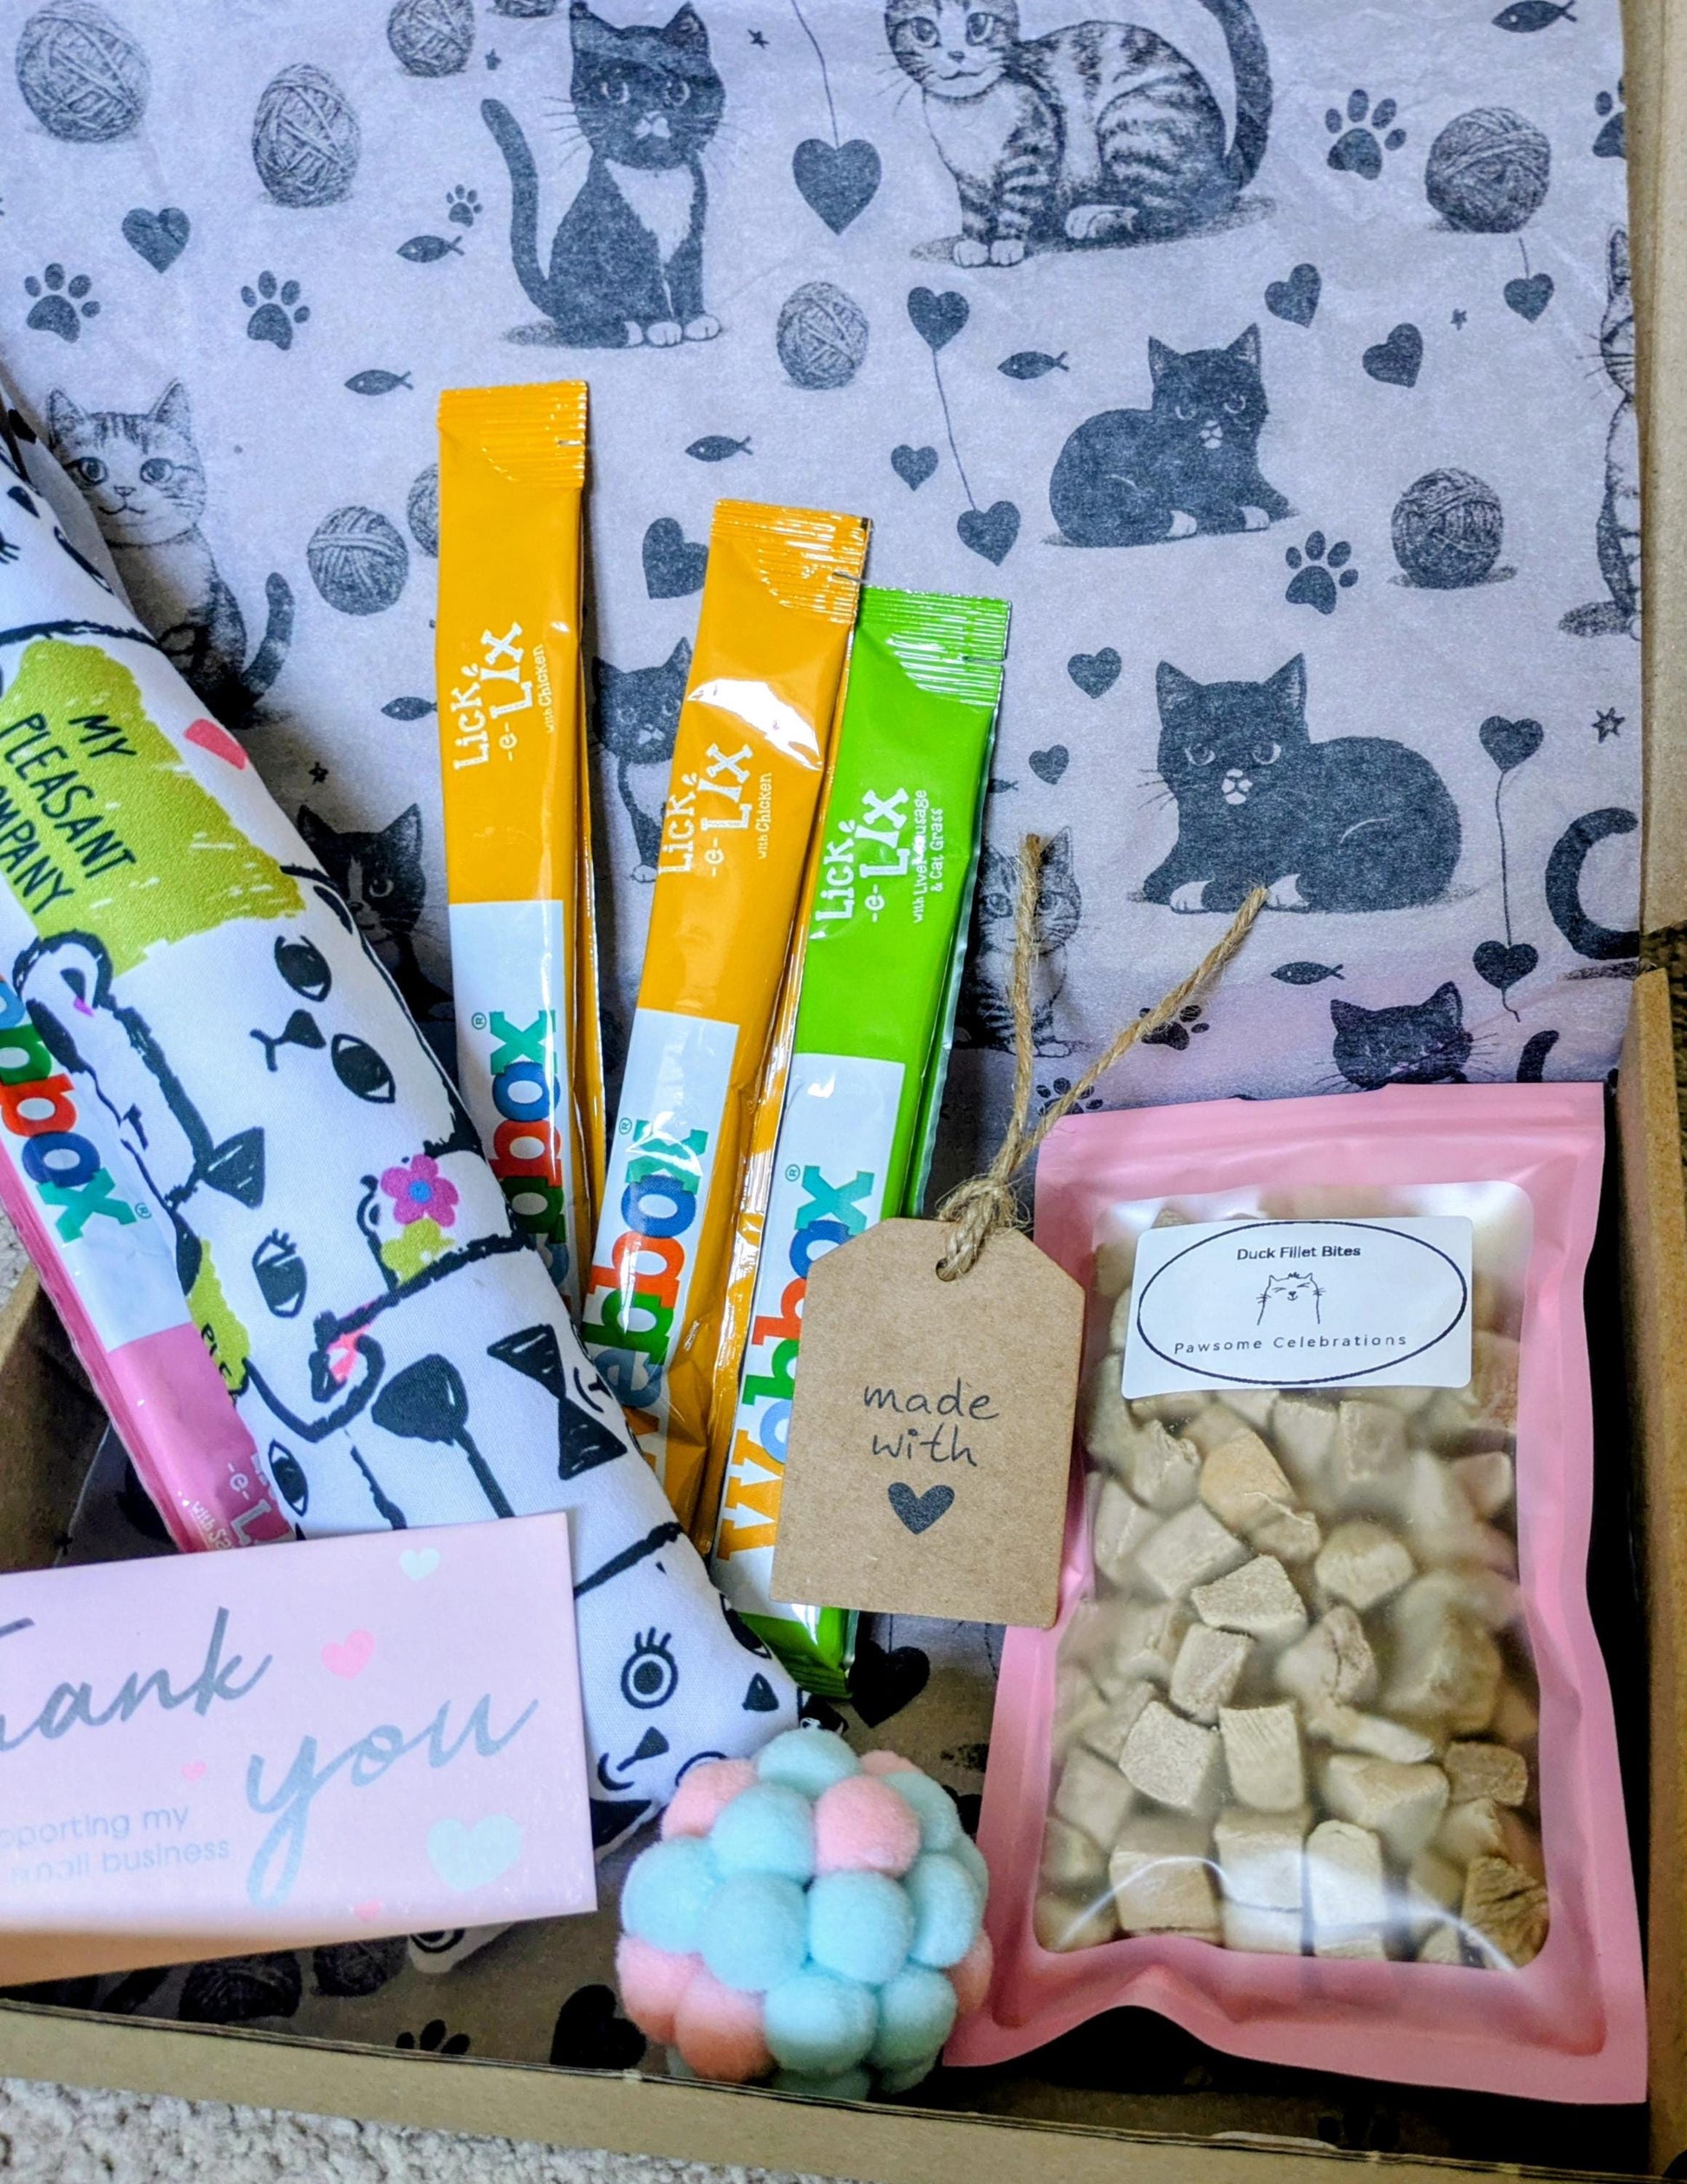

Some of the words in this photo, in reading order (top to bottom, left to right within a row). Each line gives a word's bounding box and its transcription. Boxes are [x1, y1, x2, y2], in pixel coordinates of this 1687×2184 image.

[532, 643, 553, 707] Chicken
[68, 714, 137, 758] MY
[543, 707, 556, 733] with
[0, 712, 137, 879] PLEASANT
[755, 772, 772, 834] Chicken
[912, 790, 928, 856] usage
[930, 807, 943, 851] Grass
[757, 834, 769, 860] with
[930, 854, 944, 879] Cat
[930, 882, 943, 892] &
[912, 896, 924, 923] with
[1237, 1247, 1276, 1261] Duck
[1280, 1246, 1317, 1259] Fillet
[1321, 1245, 1361, 1258] Bites
[1174, 1340, 1263, 1354] Pawsome
[1273, 1333, 1407, 1349] Celebrations
[863, 1377, 1000, 1420] made
[872, 1422, 977, 1467] with
[0, 1605, 273, 1752] ank
[142, 1805, 191, 1832] my
[246, 1692, 539, 1912] you
[101, 1839, 231, 1874] business
